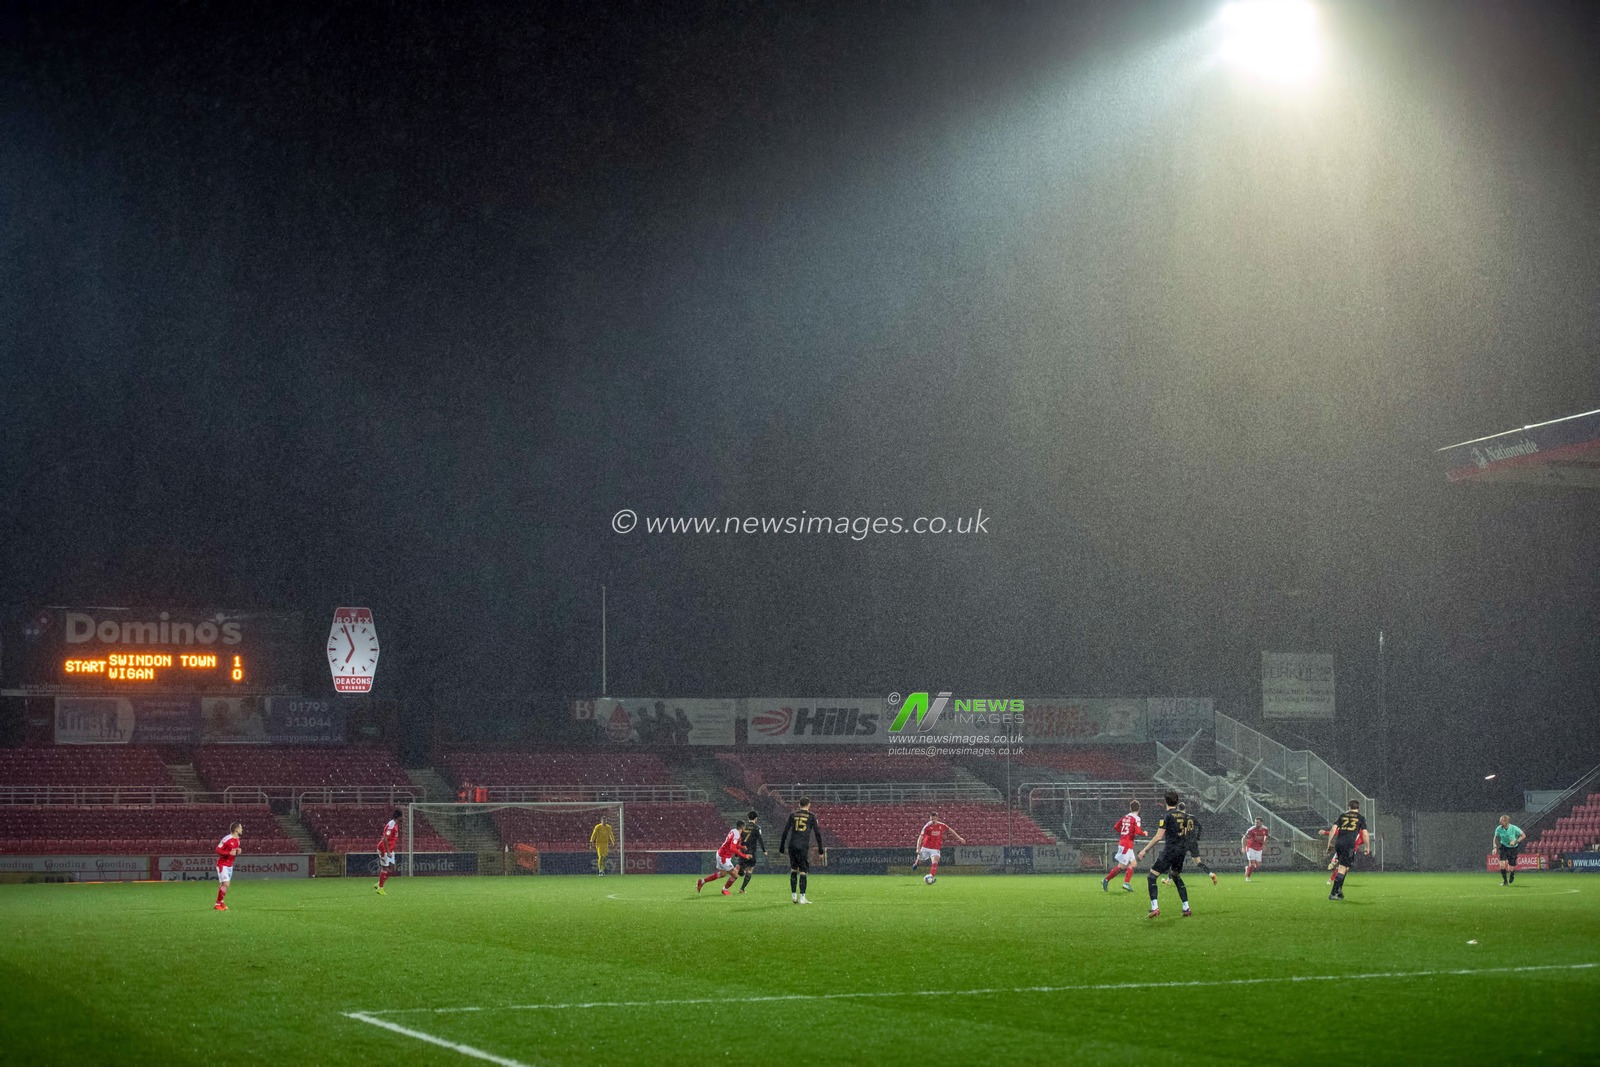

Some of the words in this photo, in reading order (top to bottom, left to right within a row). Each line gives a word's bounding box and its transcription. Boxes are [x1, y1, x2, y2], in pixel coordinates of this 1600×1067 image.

[1485, 439, 1540, 461] Nationwide
[336, 616, 370, 624] ROLEX
[65, 611, 242, 645] Domino's
[65, 661, 107, 672] START
[109, 654, 172, 667] SWINDON
[180, 655, 217, 667] TOWN
[233, 655, 241, 667] 1
[109, 667, 154, 680] WIGAN
[232, 668, 243, 681] 0
[335, 677, 371, 685] DEACONS
[289, 701, 328, 712] 01793
[285, 717, 331, 728] 313044
[793, 708, 880, 735] Hills
[794, 817, 808, 832] 15
[1340, 817, 1359, 831] 23
[95, 859, 137, 871] Gooding
[396, 858, 455, 871] atonwide
[591, 857, 616, 874] sy
[626, 856, 654, 870] bet
[1517, 857, 1538, 865] GARAGE
